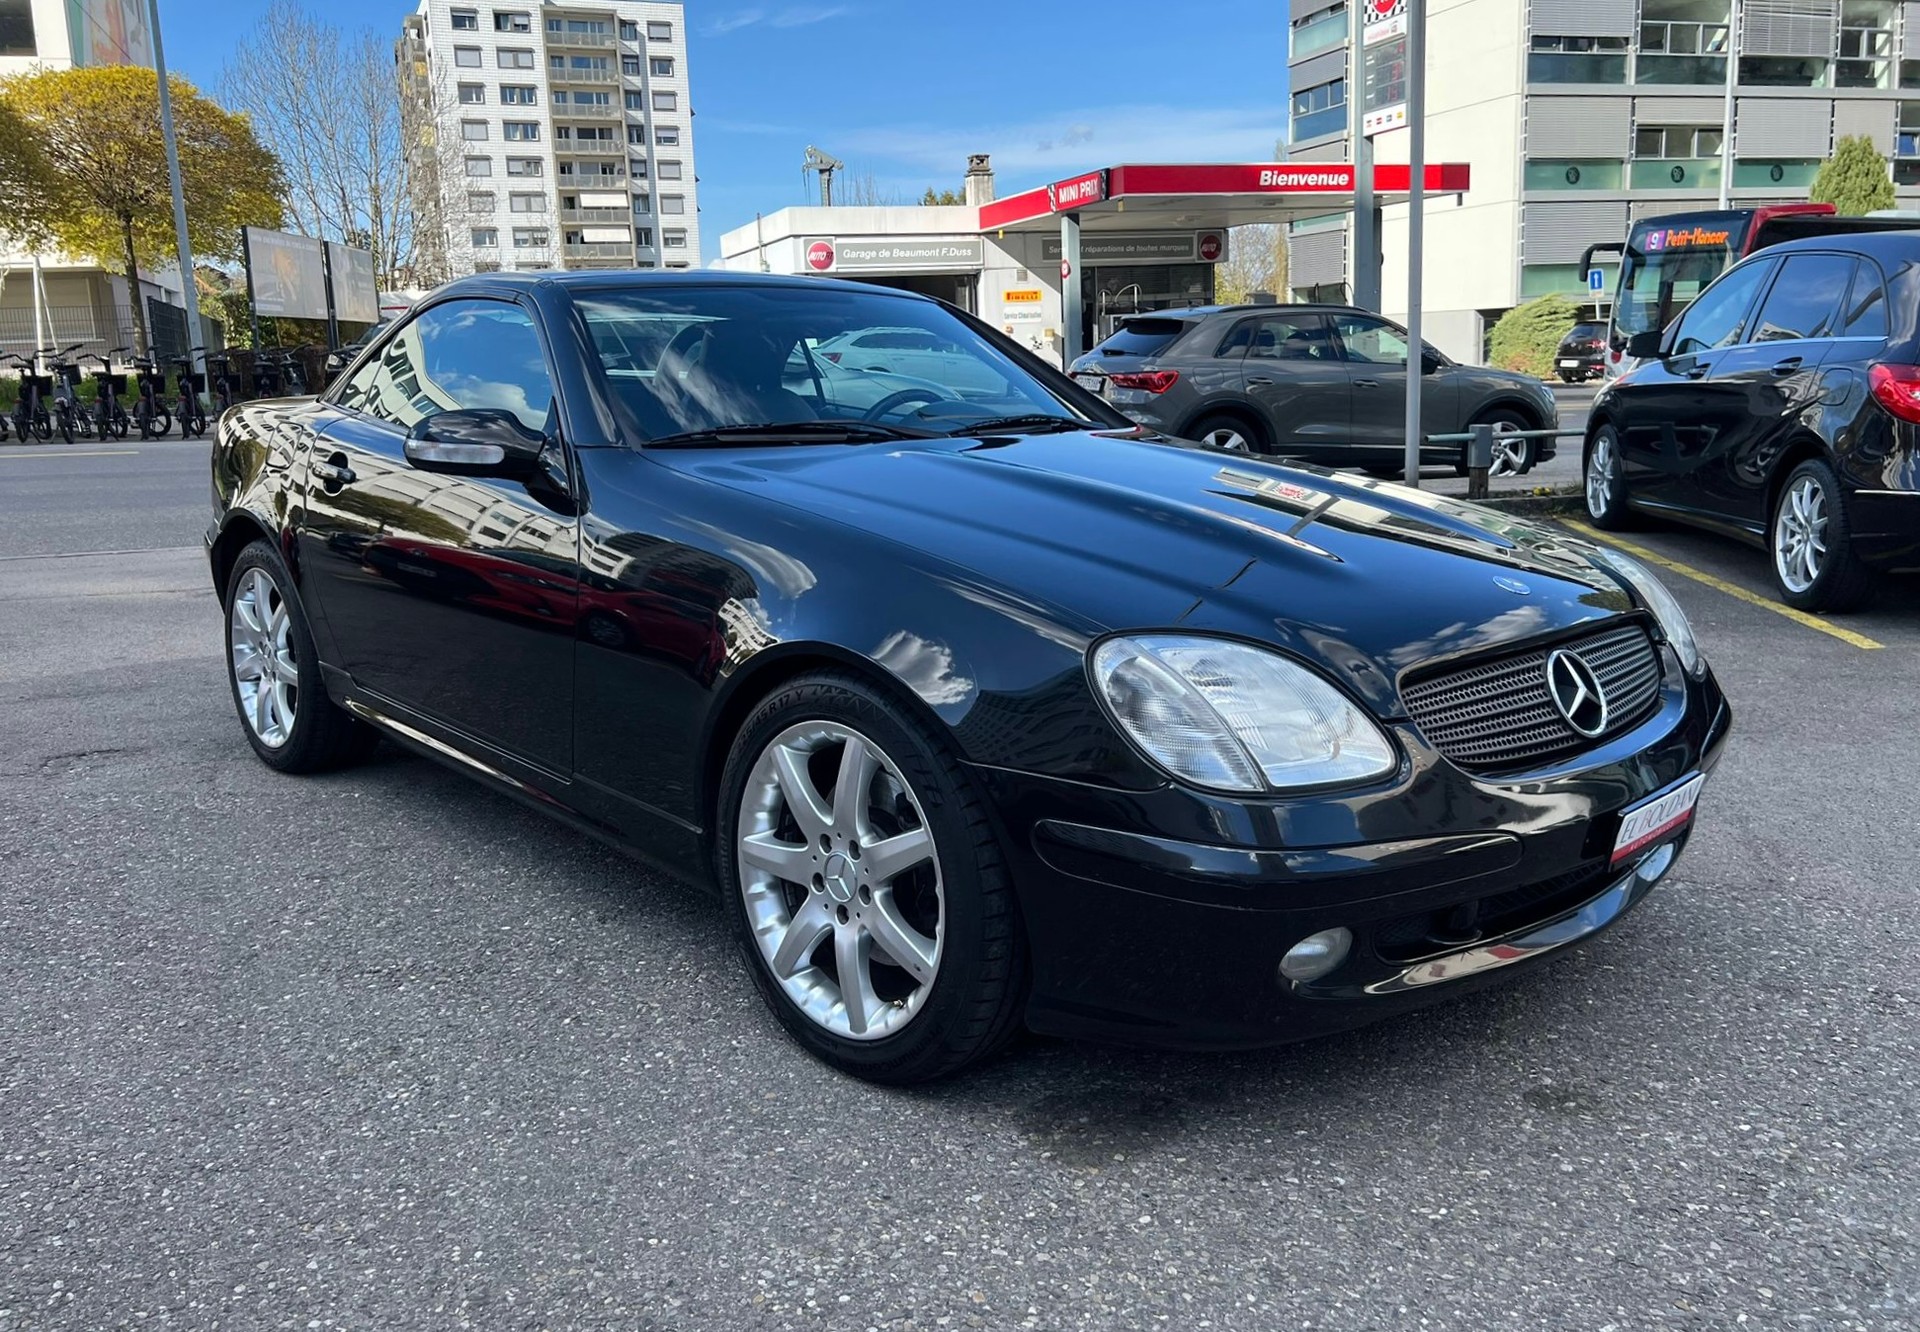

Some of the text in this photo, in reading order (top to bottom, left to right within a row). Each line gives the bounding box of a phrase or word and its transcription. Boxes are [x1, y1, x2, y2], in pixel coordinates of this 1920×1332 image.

[1259, 170, 1350, 186] Bienvenue
[1058, 177, 1099, 204] MINI PRIX
[1085, 243, 1124, 254] réparations
[1126, 244, 1135, 252] de
[1650, 232, 1659, 250] 9
[843, 246, 972, 260] Garage de Beaumont F.Duss
